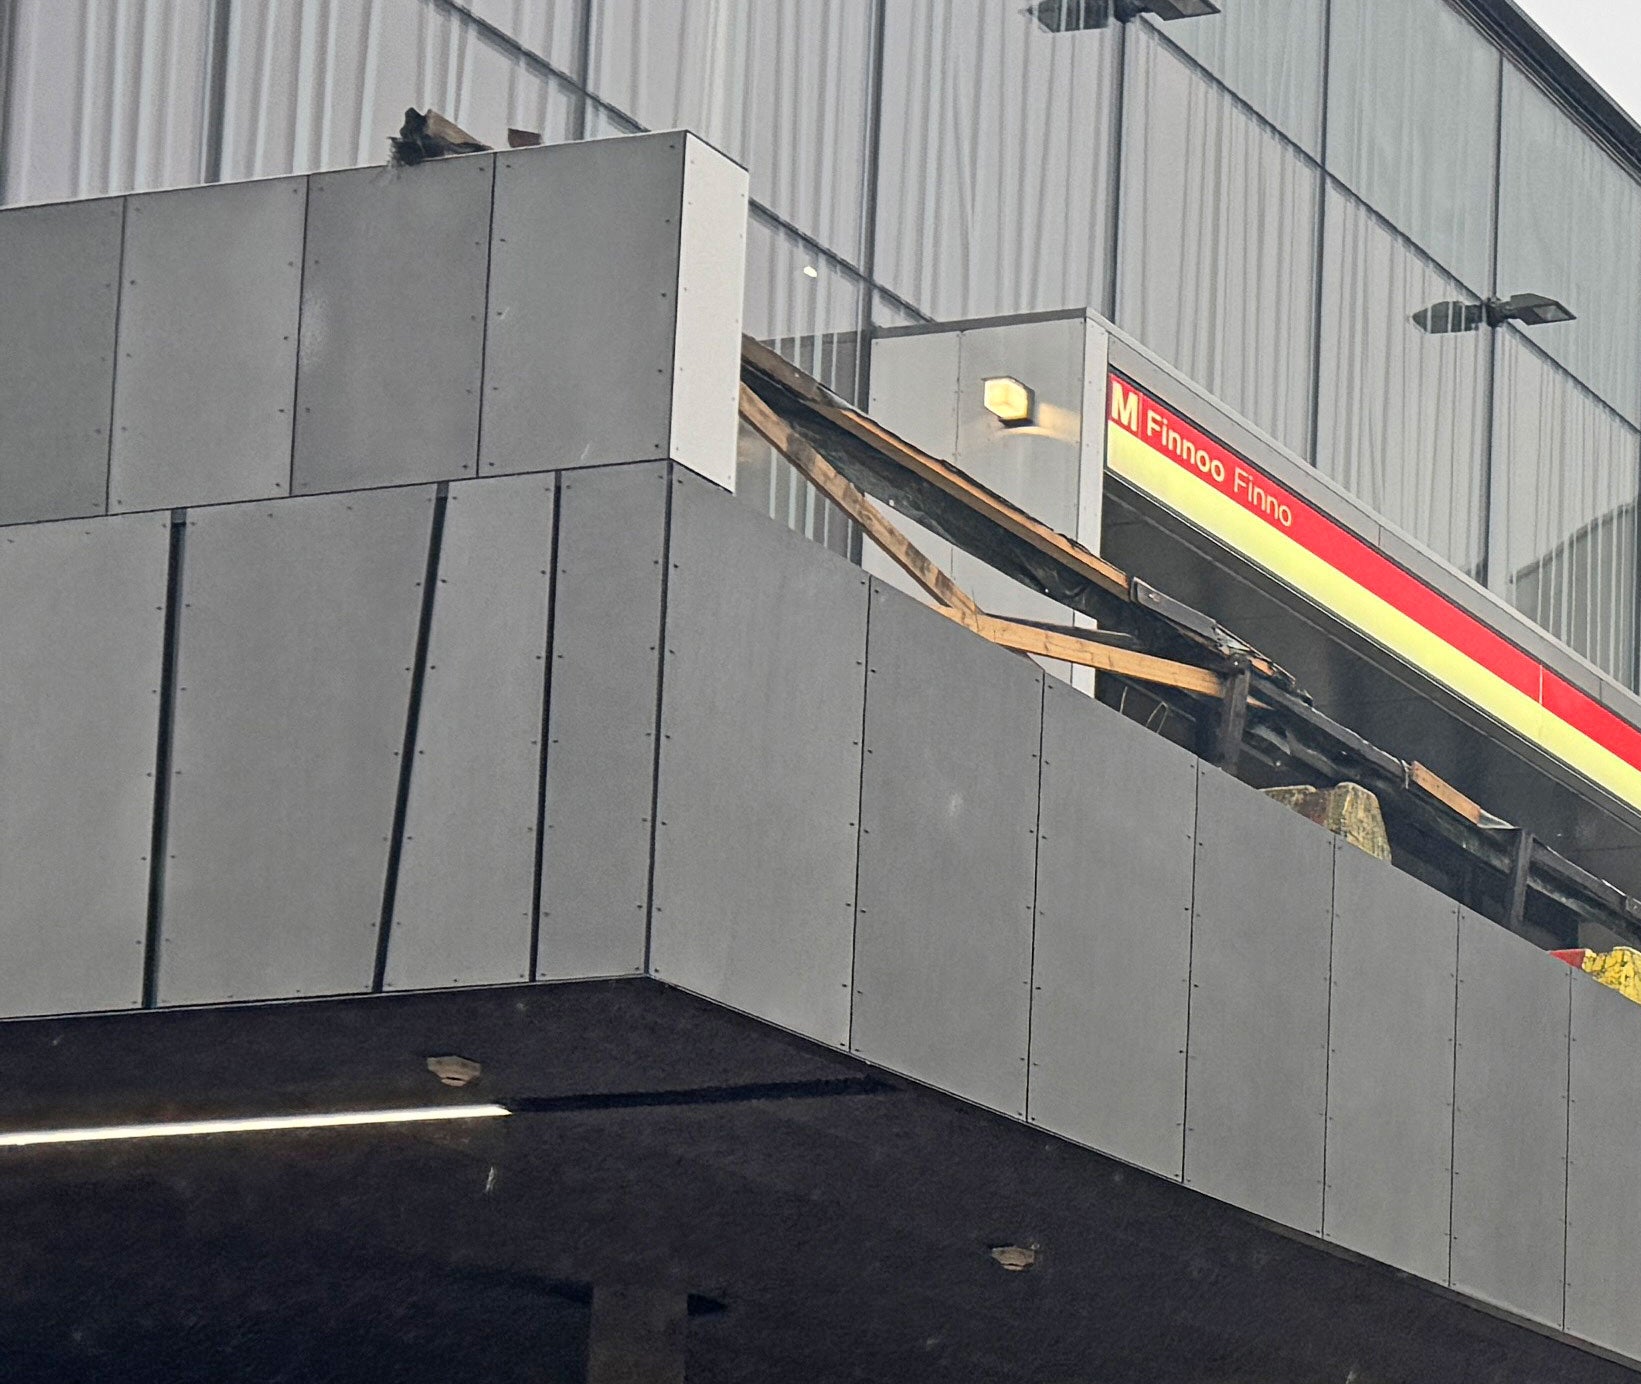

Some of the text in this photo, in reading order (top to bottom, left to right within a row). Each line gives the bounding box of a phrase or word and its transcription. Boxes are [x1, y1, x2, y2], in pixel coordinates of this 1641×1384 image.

[1111, 382, 1293, 528] M Finnoo Finno
